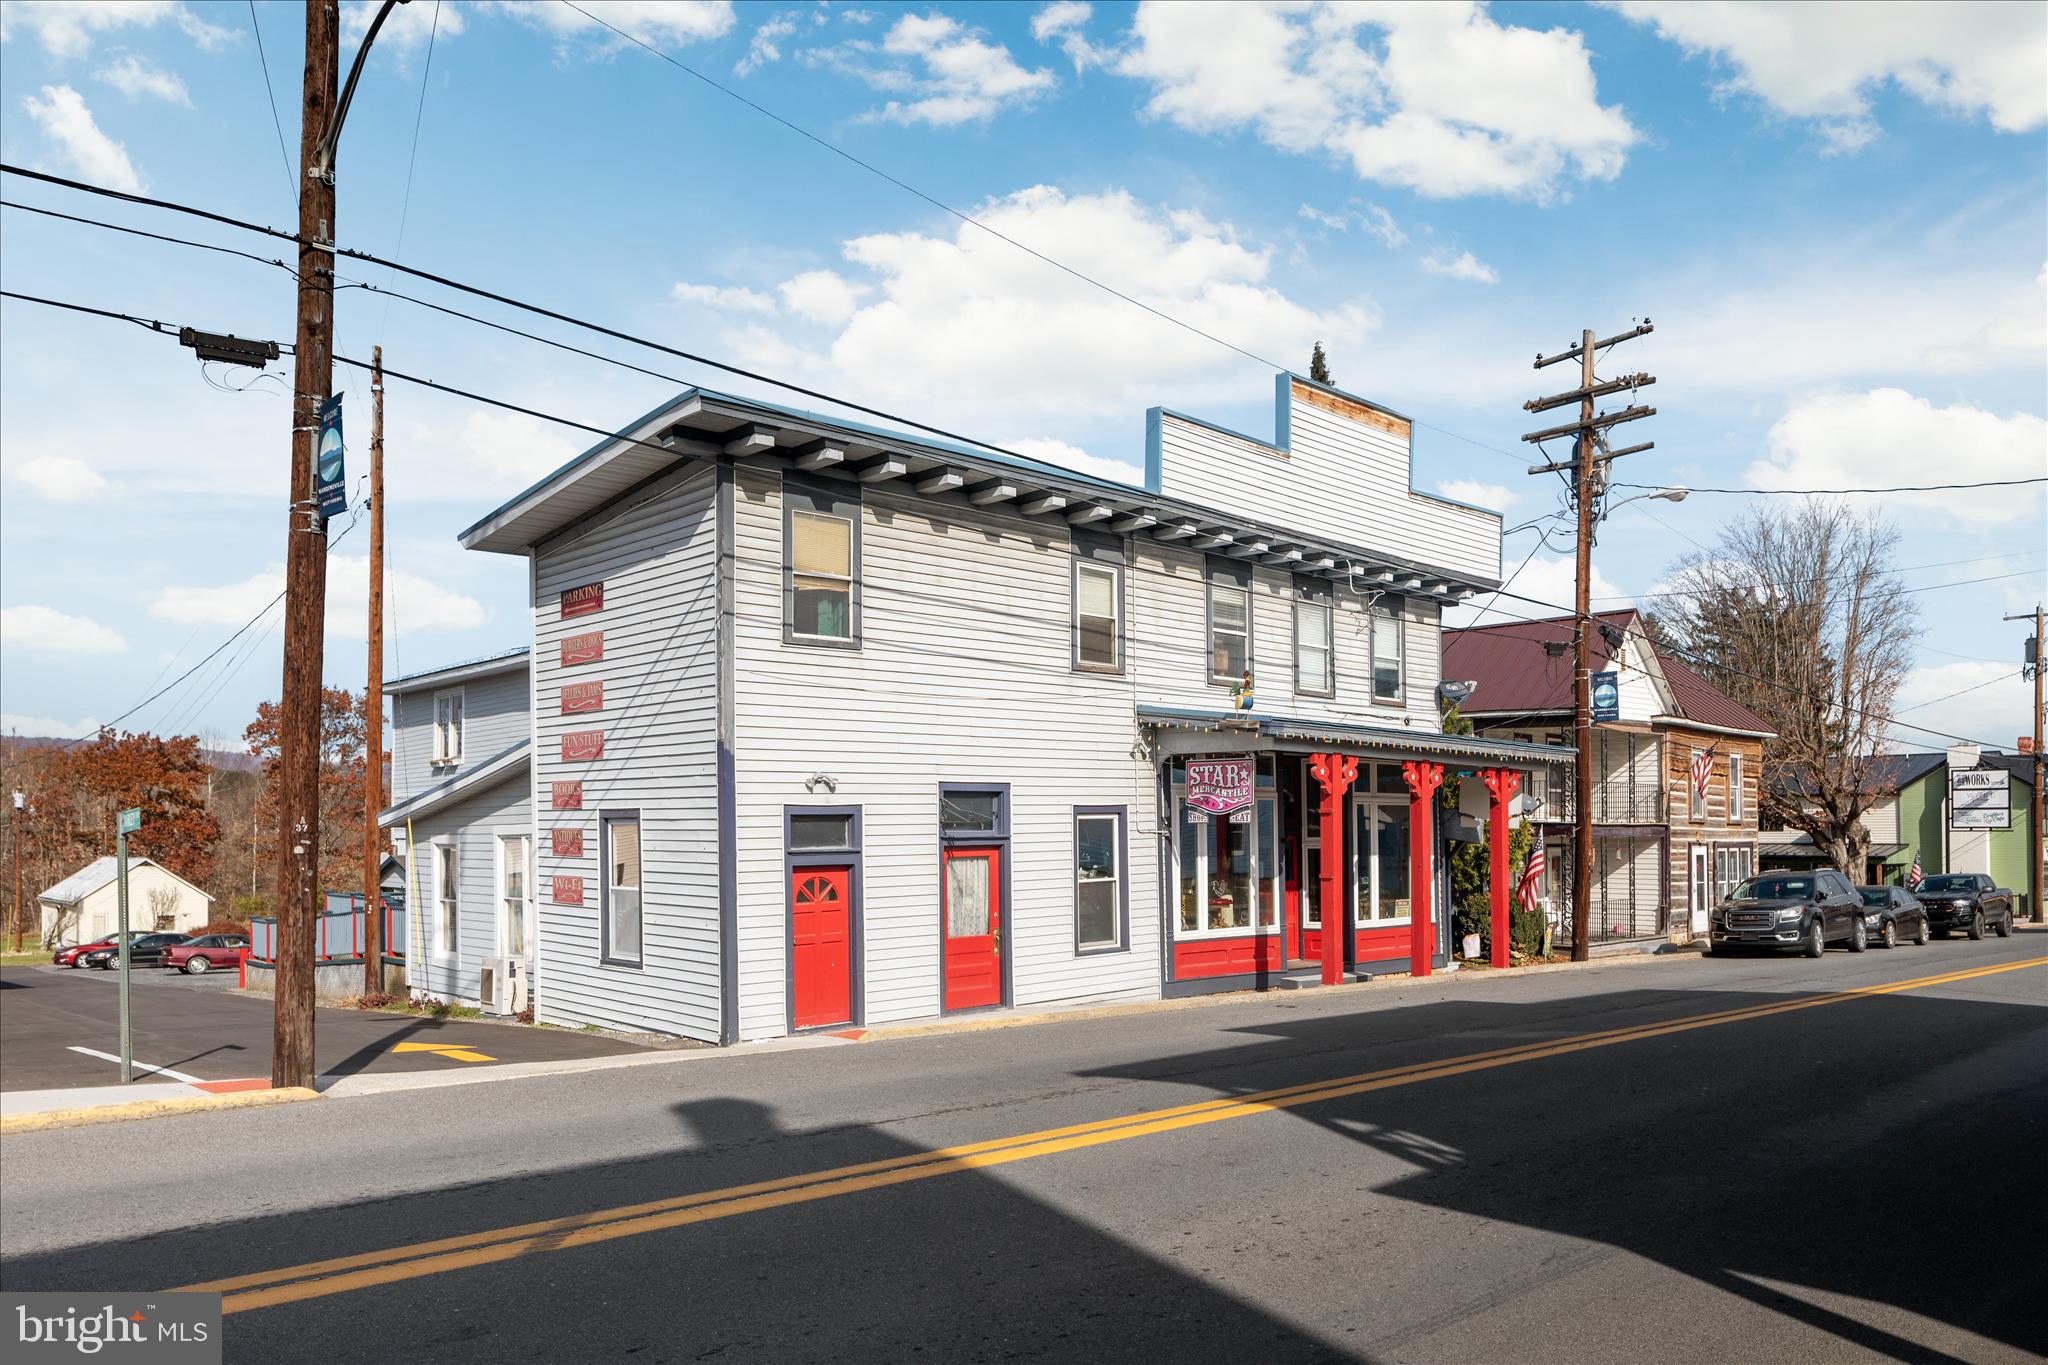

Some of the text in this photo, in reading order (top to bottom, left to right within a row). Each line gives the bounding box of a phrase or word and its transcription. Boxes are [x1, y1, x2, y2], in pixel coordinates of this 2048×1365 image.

[563, 584, 602, 605] PARKING
[588, 634, 602, 648] DOGS
[562, 683, 602, 700] JELLIES & JAMS
[563, 733, 602, 748] FUN STUFF
[1190, 764, 1240, 788] STAR
[554, 783, 581, 796] BOOKS
[1191, 785, 1249, 797] MERCANTILE
[300, 815, 306, 824] A
[295, 824, 308, 832] 37
[554, 830, 582, 845] ANTIQUES
